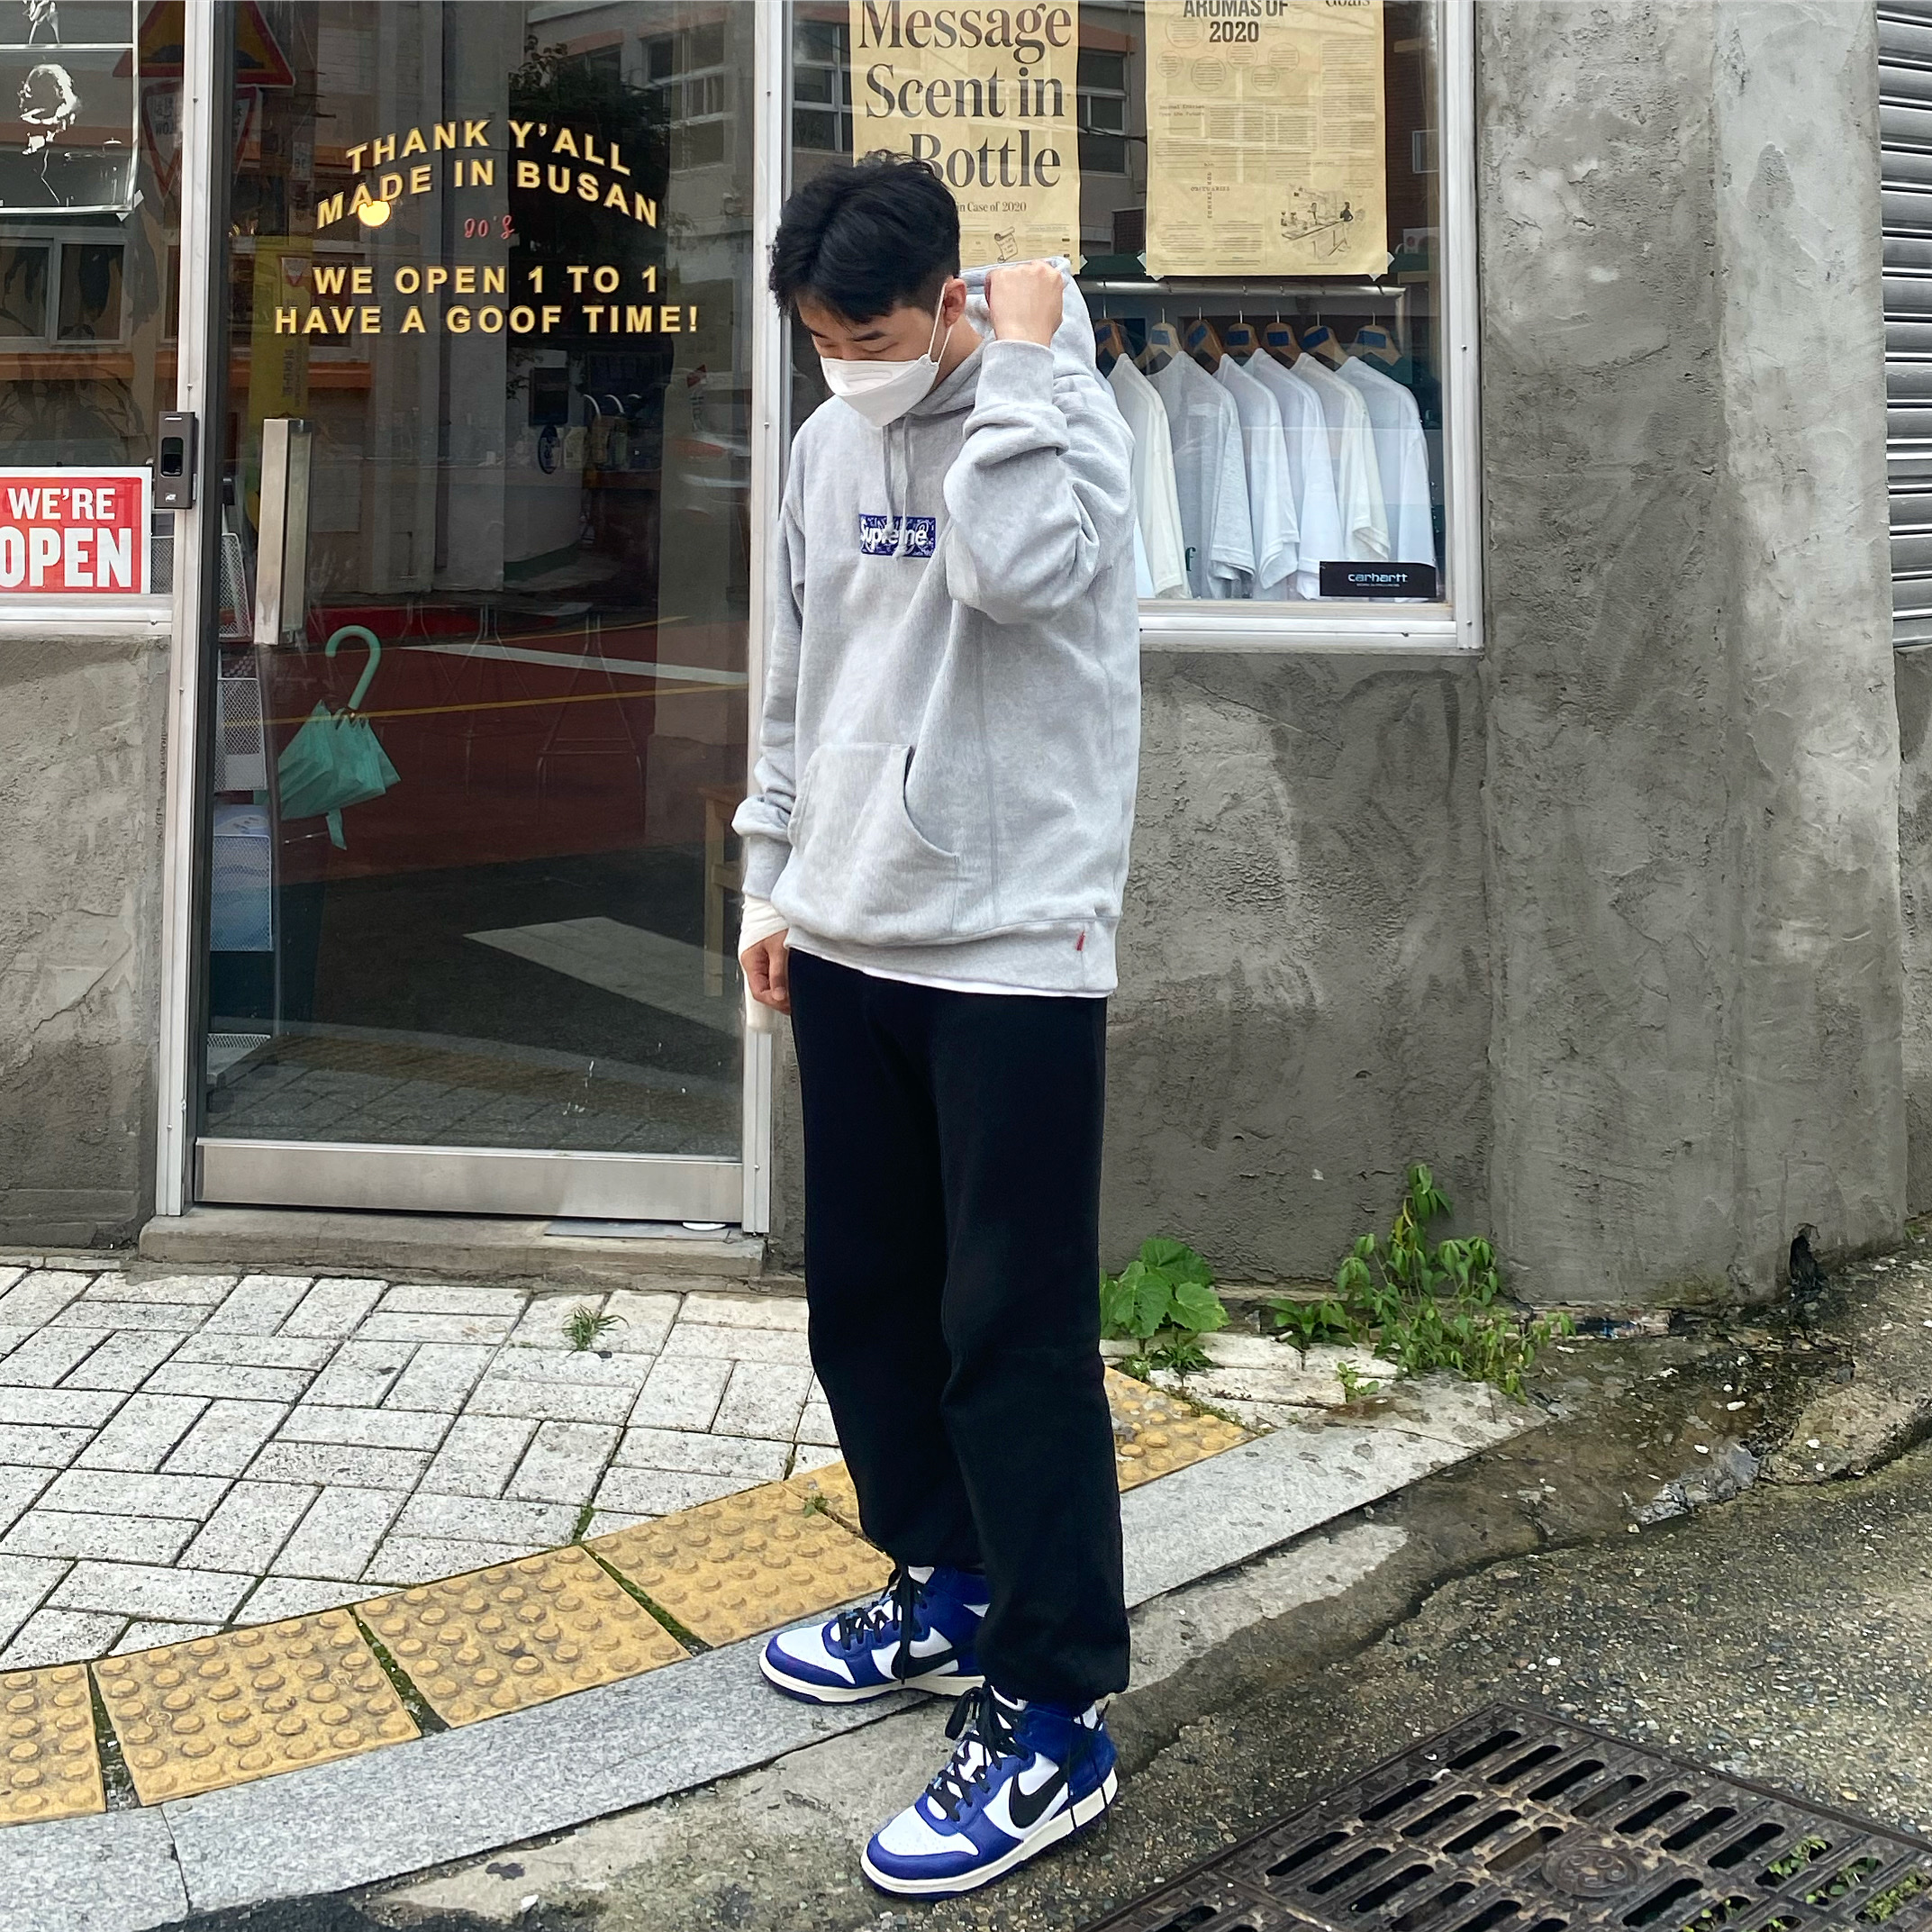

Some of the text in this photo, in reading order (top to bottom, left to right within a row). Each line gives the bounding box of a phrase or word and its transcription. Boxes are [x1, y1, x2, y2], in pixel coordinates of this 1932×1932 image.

[1184, 0, 1260, 18] AROMAS
[1265, 0, 1289, 17] OF
[858, 0, 1072, 64] Message
[1210, 21, 1259, 42] 2020
[866, 63, 1065, 118] Scent in
[346, 119, 631, 177] THANK Y'ALL
[910, 130, 1061, 187] Bottle
[317, 159, 657, 229] MADE IN BUSAN
[967, 201, 989, 212] Case
[990, 201, 1001, 212] of
[1002, 201, 1027, 212] 2020
[312, 265, 657, 294] WE OPEN 1 TO 1
[275, 304, 697, 334] HAVE A GOOF TIME!
[7, 487, 116, 521] WE'RE
[0, 525, 132, 588] OPEN
[1347, 573, 1409, 583] carhartt
